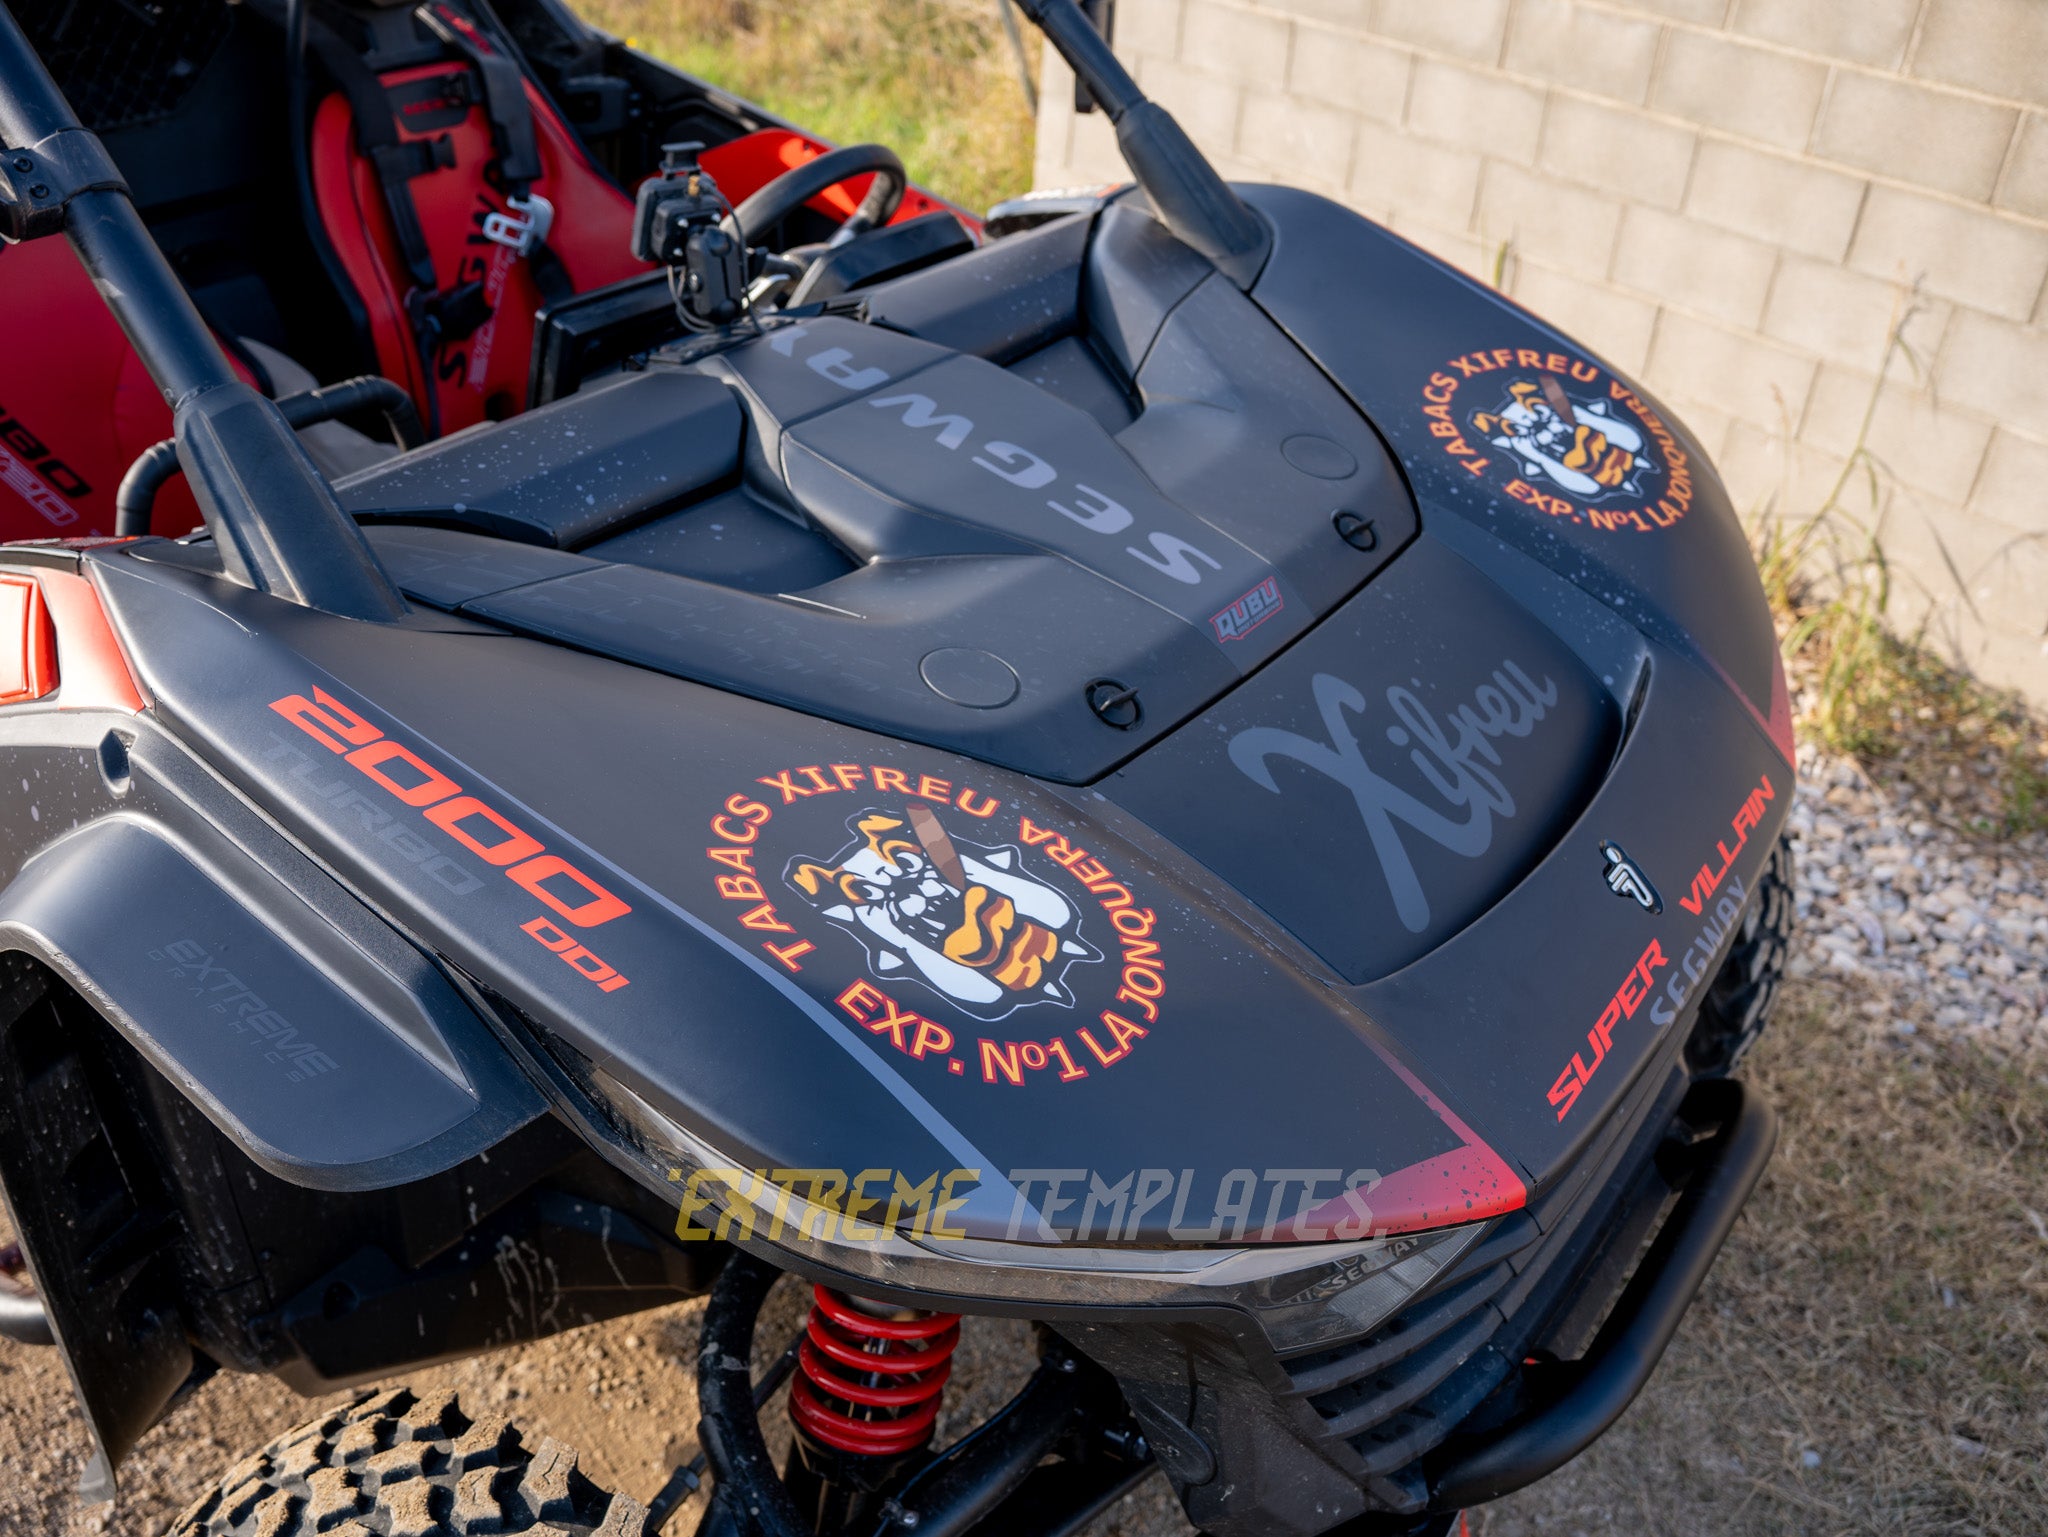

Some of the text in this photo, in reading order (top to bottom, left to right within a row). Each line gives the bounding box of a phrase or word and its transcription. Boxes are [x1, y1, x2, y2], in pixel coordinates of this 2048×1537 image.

[0, 404, 93, 498] BO
[1422, 347, 1600, 477] TABACS XIFREU
[1503, 478, 1584, 524] EXP.
[1213, 579, 1279, 638] QUBU
[260, 730, 487, 896] TURBO
[268, 684, 632, 928] 2000
[1228, 657, 1558, 933] Xifreu
[707, 763, 1002, 972] TABACS XIFREU
[164, 939, 341, 1079] EXTREME
[518, 915, 631, 993] DDI
[1546, 774, 1776, 1123] SUPER VILLAIN
[148, 949, 307, 1084] GRAPHICS
[833, 978, 965, 1076] EXP.
